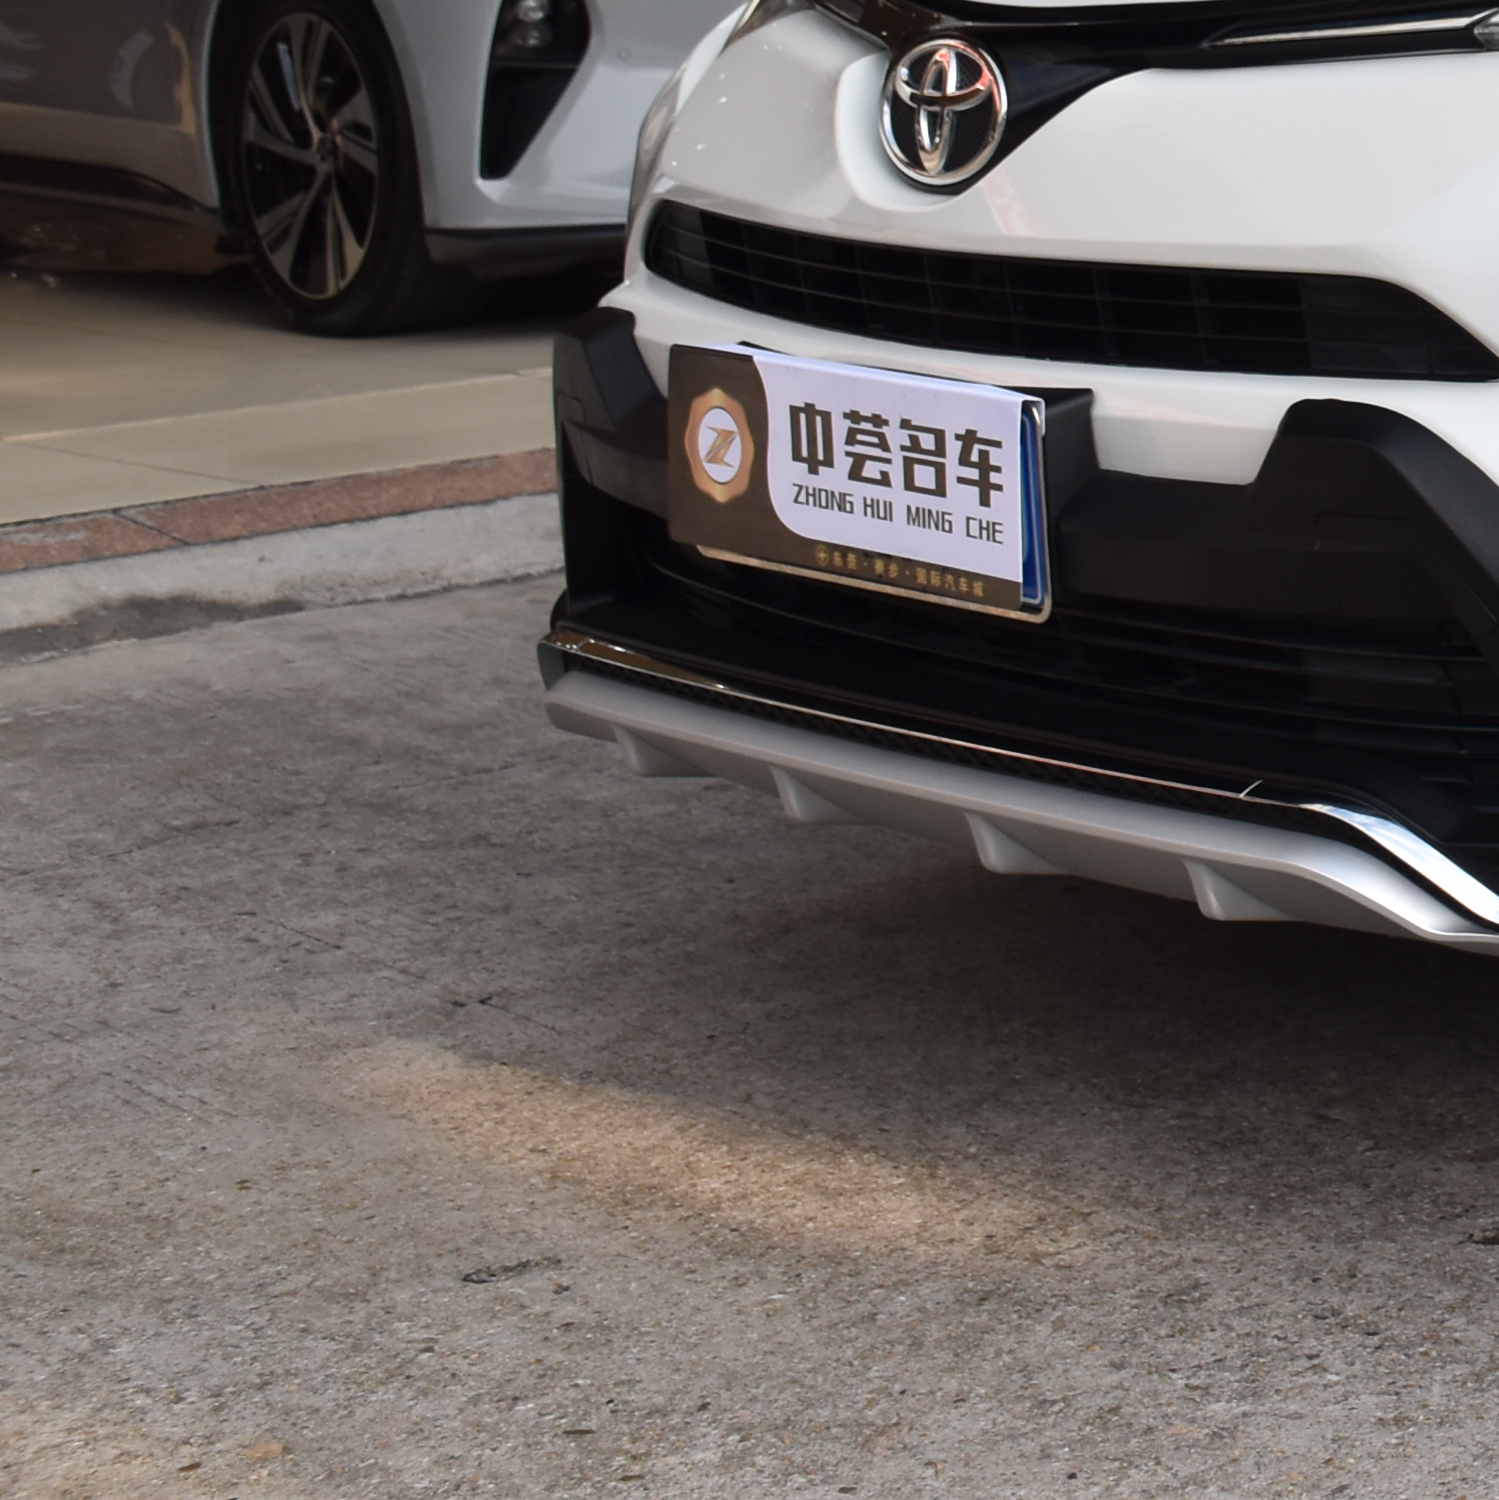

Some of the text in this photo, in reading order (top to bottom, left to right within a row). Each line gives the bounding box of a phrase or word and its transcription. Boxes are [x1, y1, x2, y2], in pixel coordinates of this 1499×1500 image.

[789, 401, 1004, 509] 中荟名车
[792, 482, 1005, 545] ZHONG HUI MING CHE
